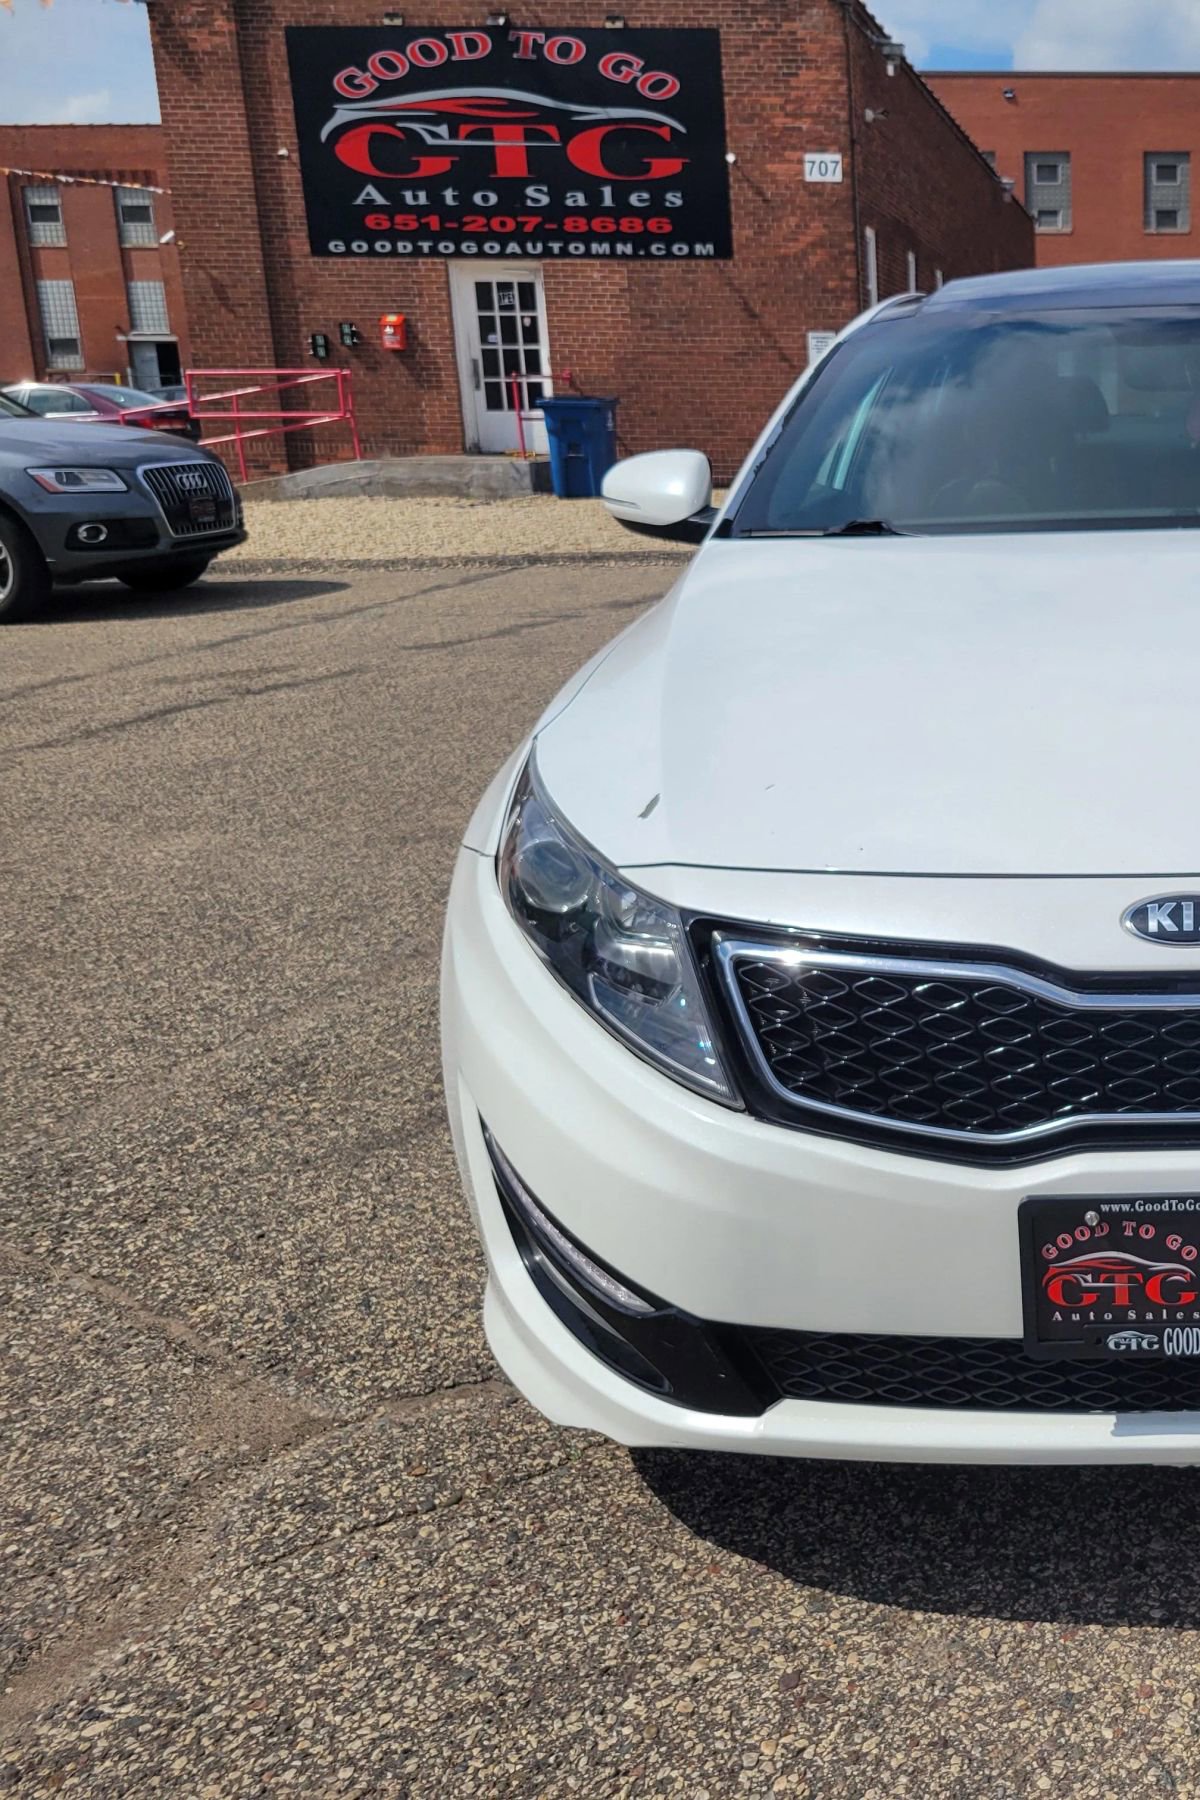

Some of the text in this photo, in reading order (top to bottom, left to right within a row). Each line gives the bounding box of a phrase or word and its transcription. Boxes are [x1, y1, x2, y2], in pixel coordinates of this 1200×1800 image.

[333, 30, 681, 101] GOOD TO GO
[334, 123, 691, 181] GTG
[807, 160, 840, 177] 707
[352, 183, 684, 208] Auto Sales
[364, 213, 674, 234] 651-207-8686
[328, 240, 715, 256] GOODTOGOAUTOMN.COM
[1041, 1220, 1198, 1261] GOOD TO GO
[1047, 1272, 1199, 1307] GTG
[1053, 1309, 1200, 1321] Auto Sales
